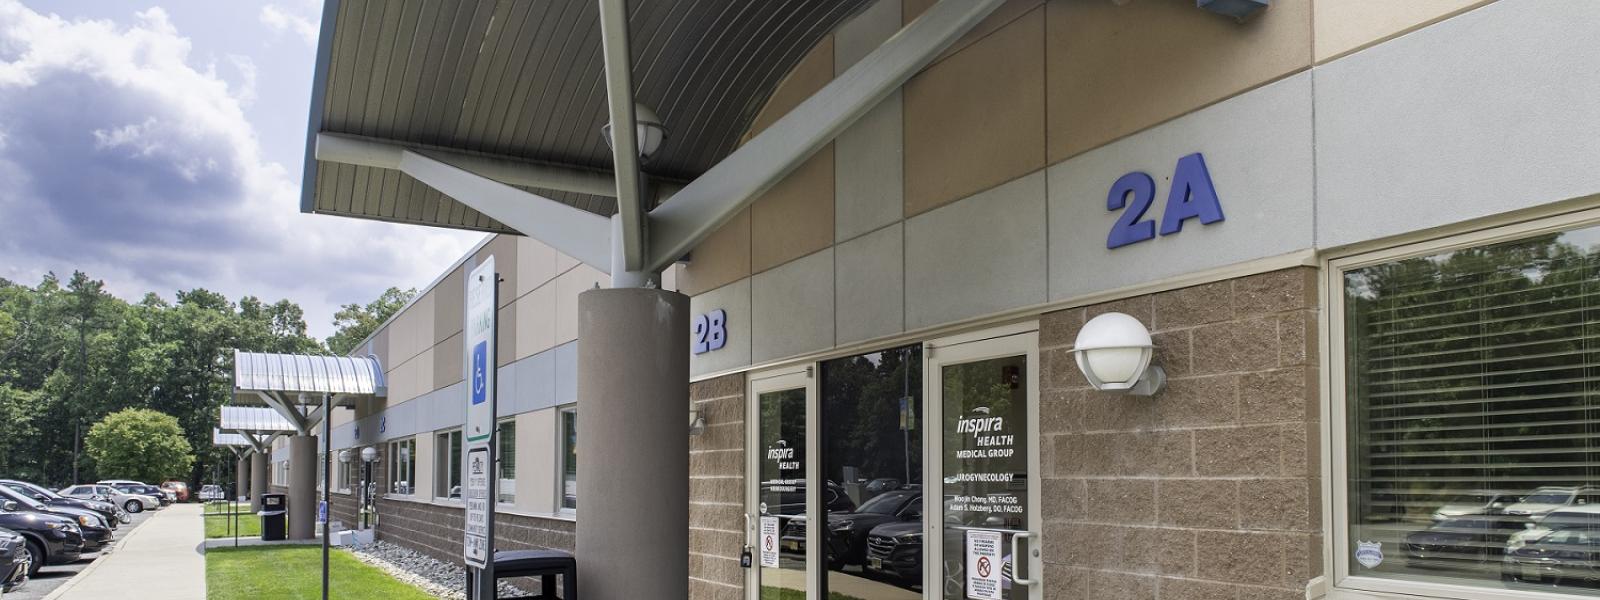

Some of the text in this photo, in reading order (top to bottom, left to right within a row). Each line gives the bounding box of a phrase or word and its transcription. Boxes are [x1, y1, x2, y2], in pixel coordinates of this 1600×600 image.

[1107, 152, 1226, 250] 2A
[694, 308, 728, 355] 2B
[957, 415, 1003, 438] inspira
[977, 435, 1014, 447] HEALTH
[767, 445, 794, 464] inspira
[956, 448, 1014, 459] MEDICAL GROUP
[779, 461, 800, 470] HEALTH
[956, 473, 1014, 482] UROGYNECOLOGY
[998, 496, 1018, 504] FACOG
[1003, 505, 1023, 513] FACOG
